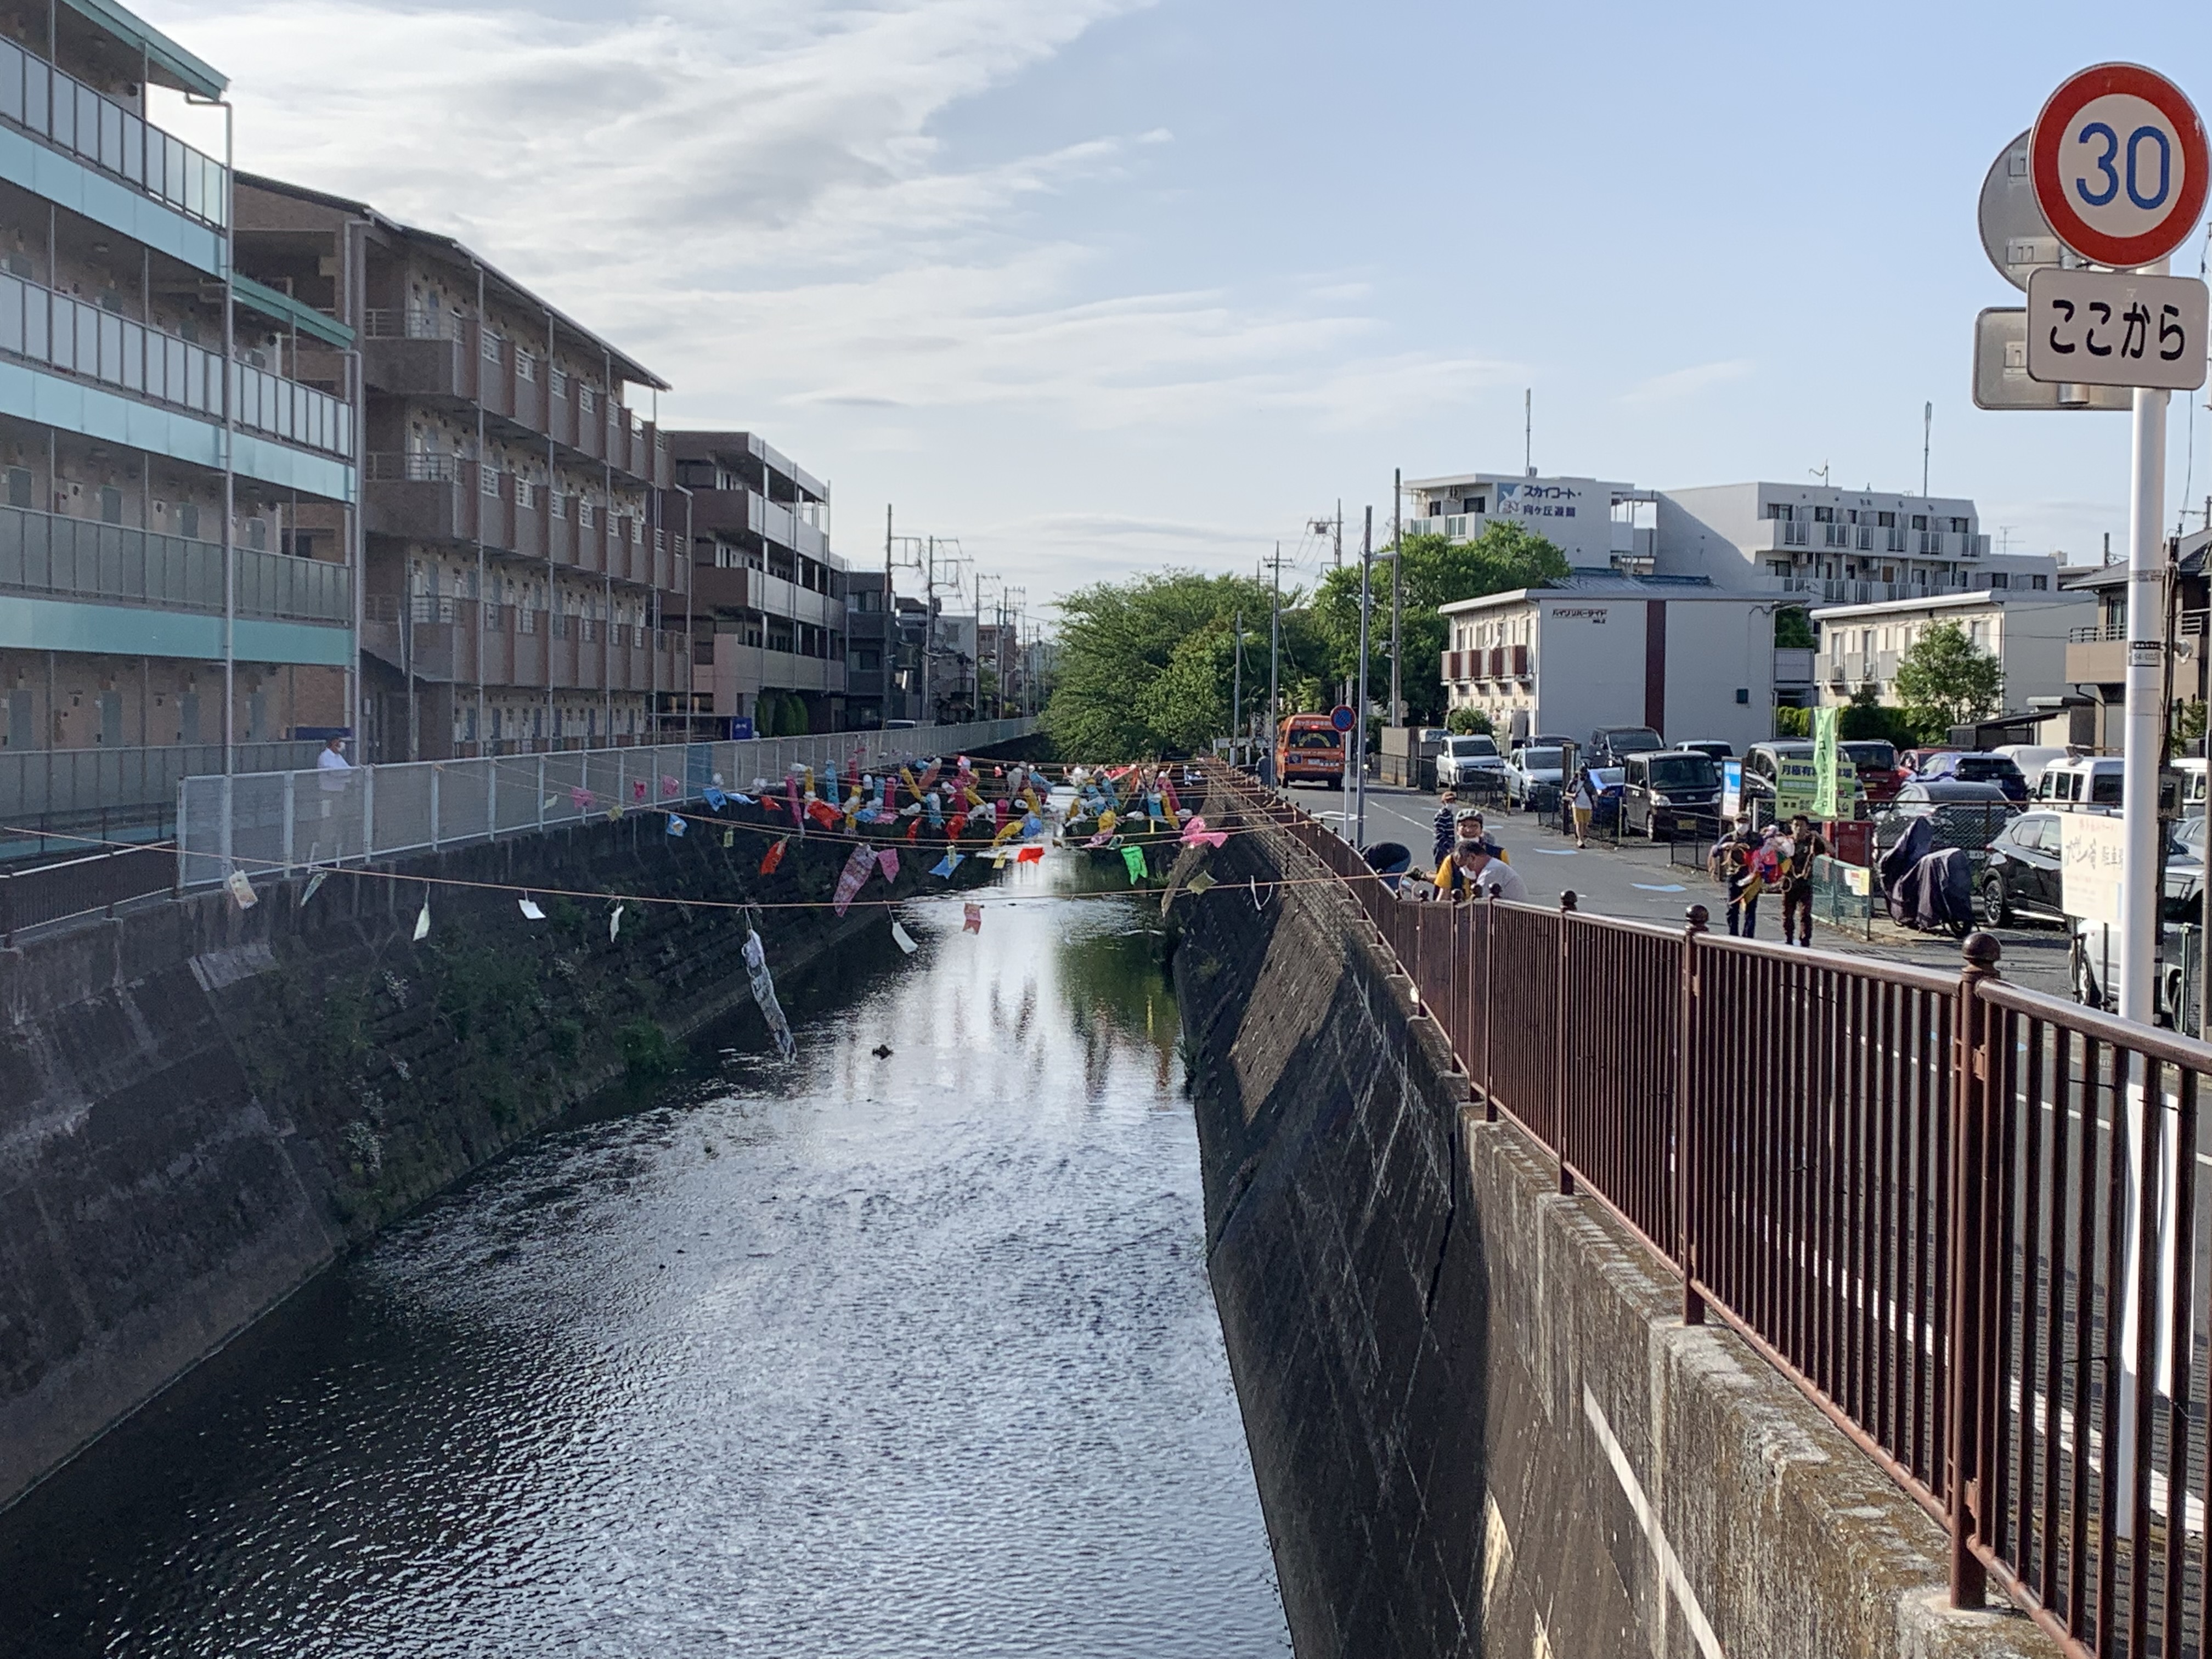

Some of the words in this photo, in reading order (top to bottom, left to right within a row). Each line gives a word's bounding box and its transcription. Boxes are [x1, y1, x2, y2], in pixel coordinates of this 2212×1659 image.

[2076, 122, 2170, 210] 30
[2050, 298, 2186, 361] ここから
